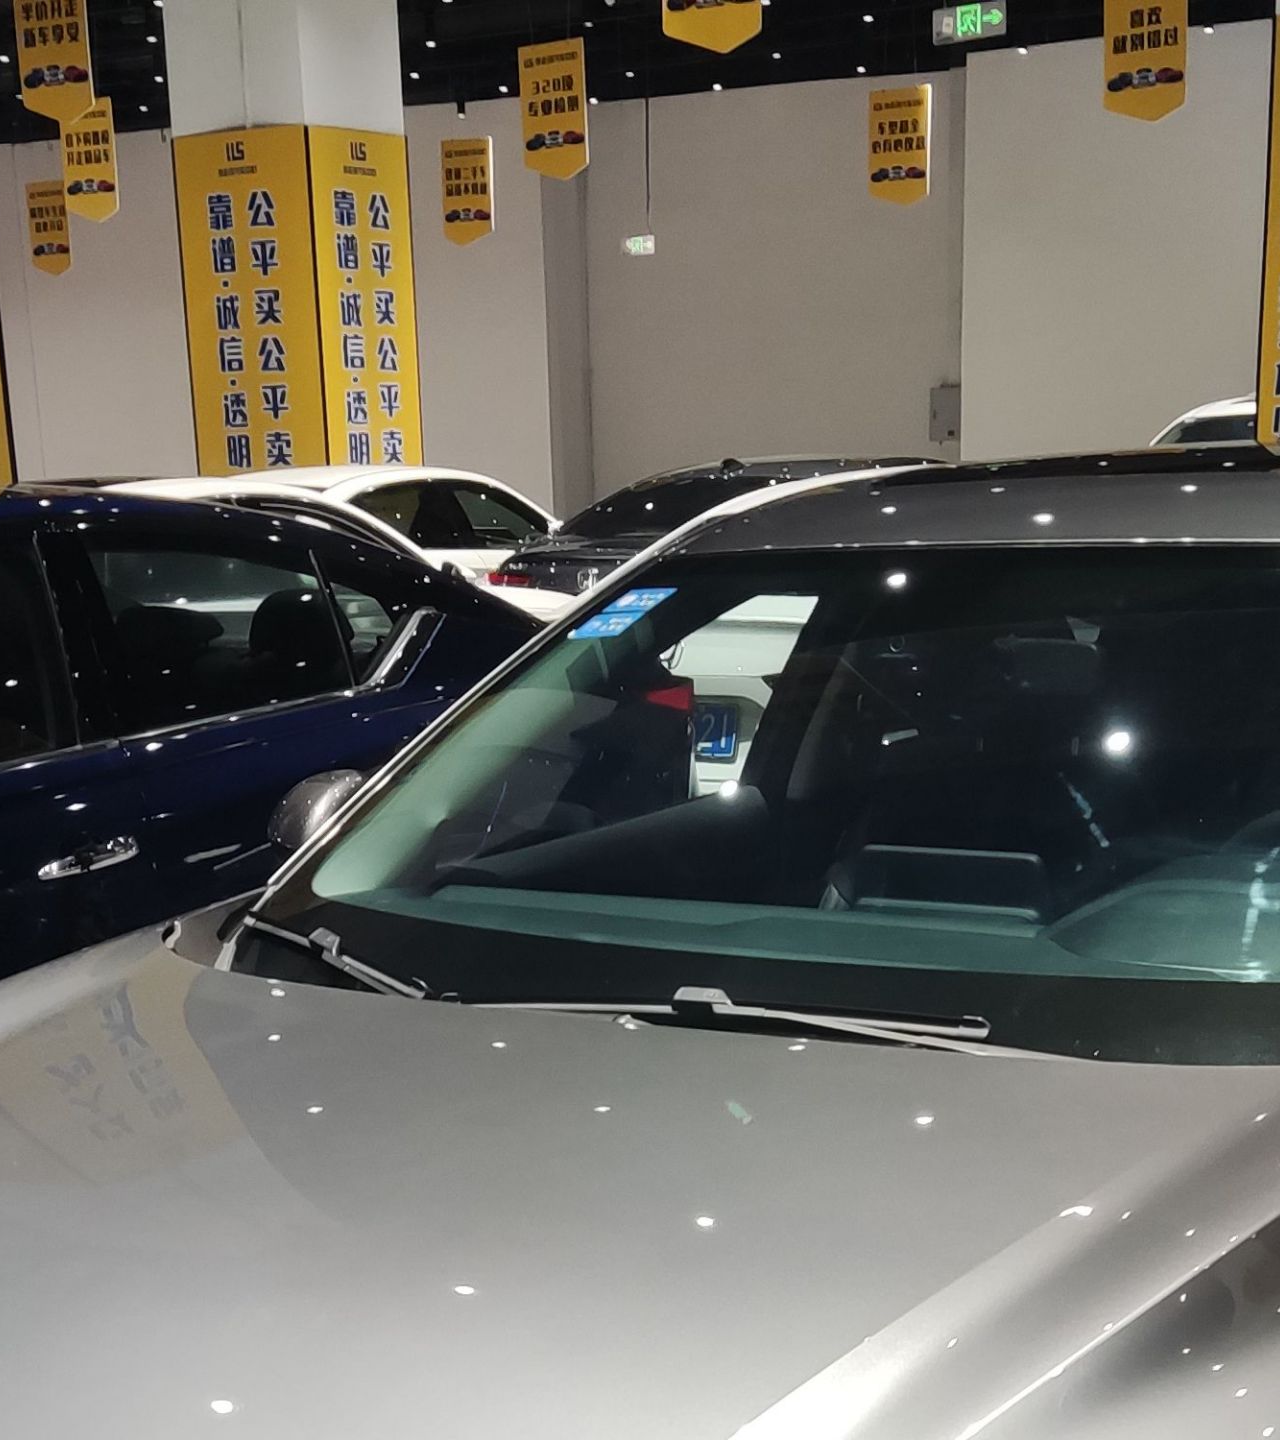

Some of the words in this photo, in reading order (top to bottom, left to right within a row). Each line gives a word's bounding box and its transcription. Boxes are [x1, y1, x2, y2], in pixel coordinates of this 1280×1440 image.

[207, 193, 252, 468] 靠谱·诚信·透明
[247, 190, 292, 466] 公平买公平卖
[332, 189, 371, 466] 靠谱·诚信·透明
[368, 193, 404, 464] 公平买公平卖
